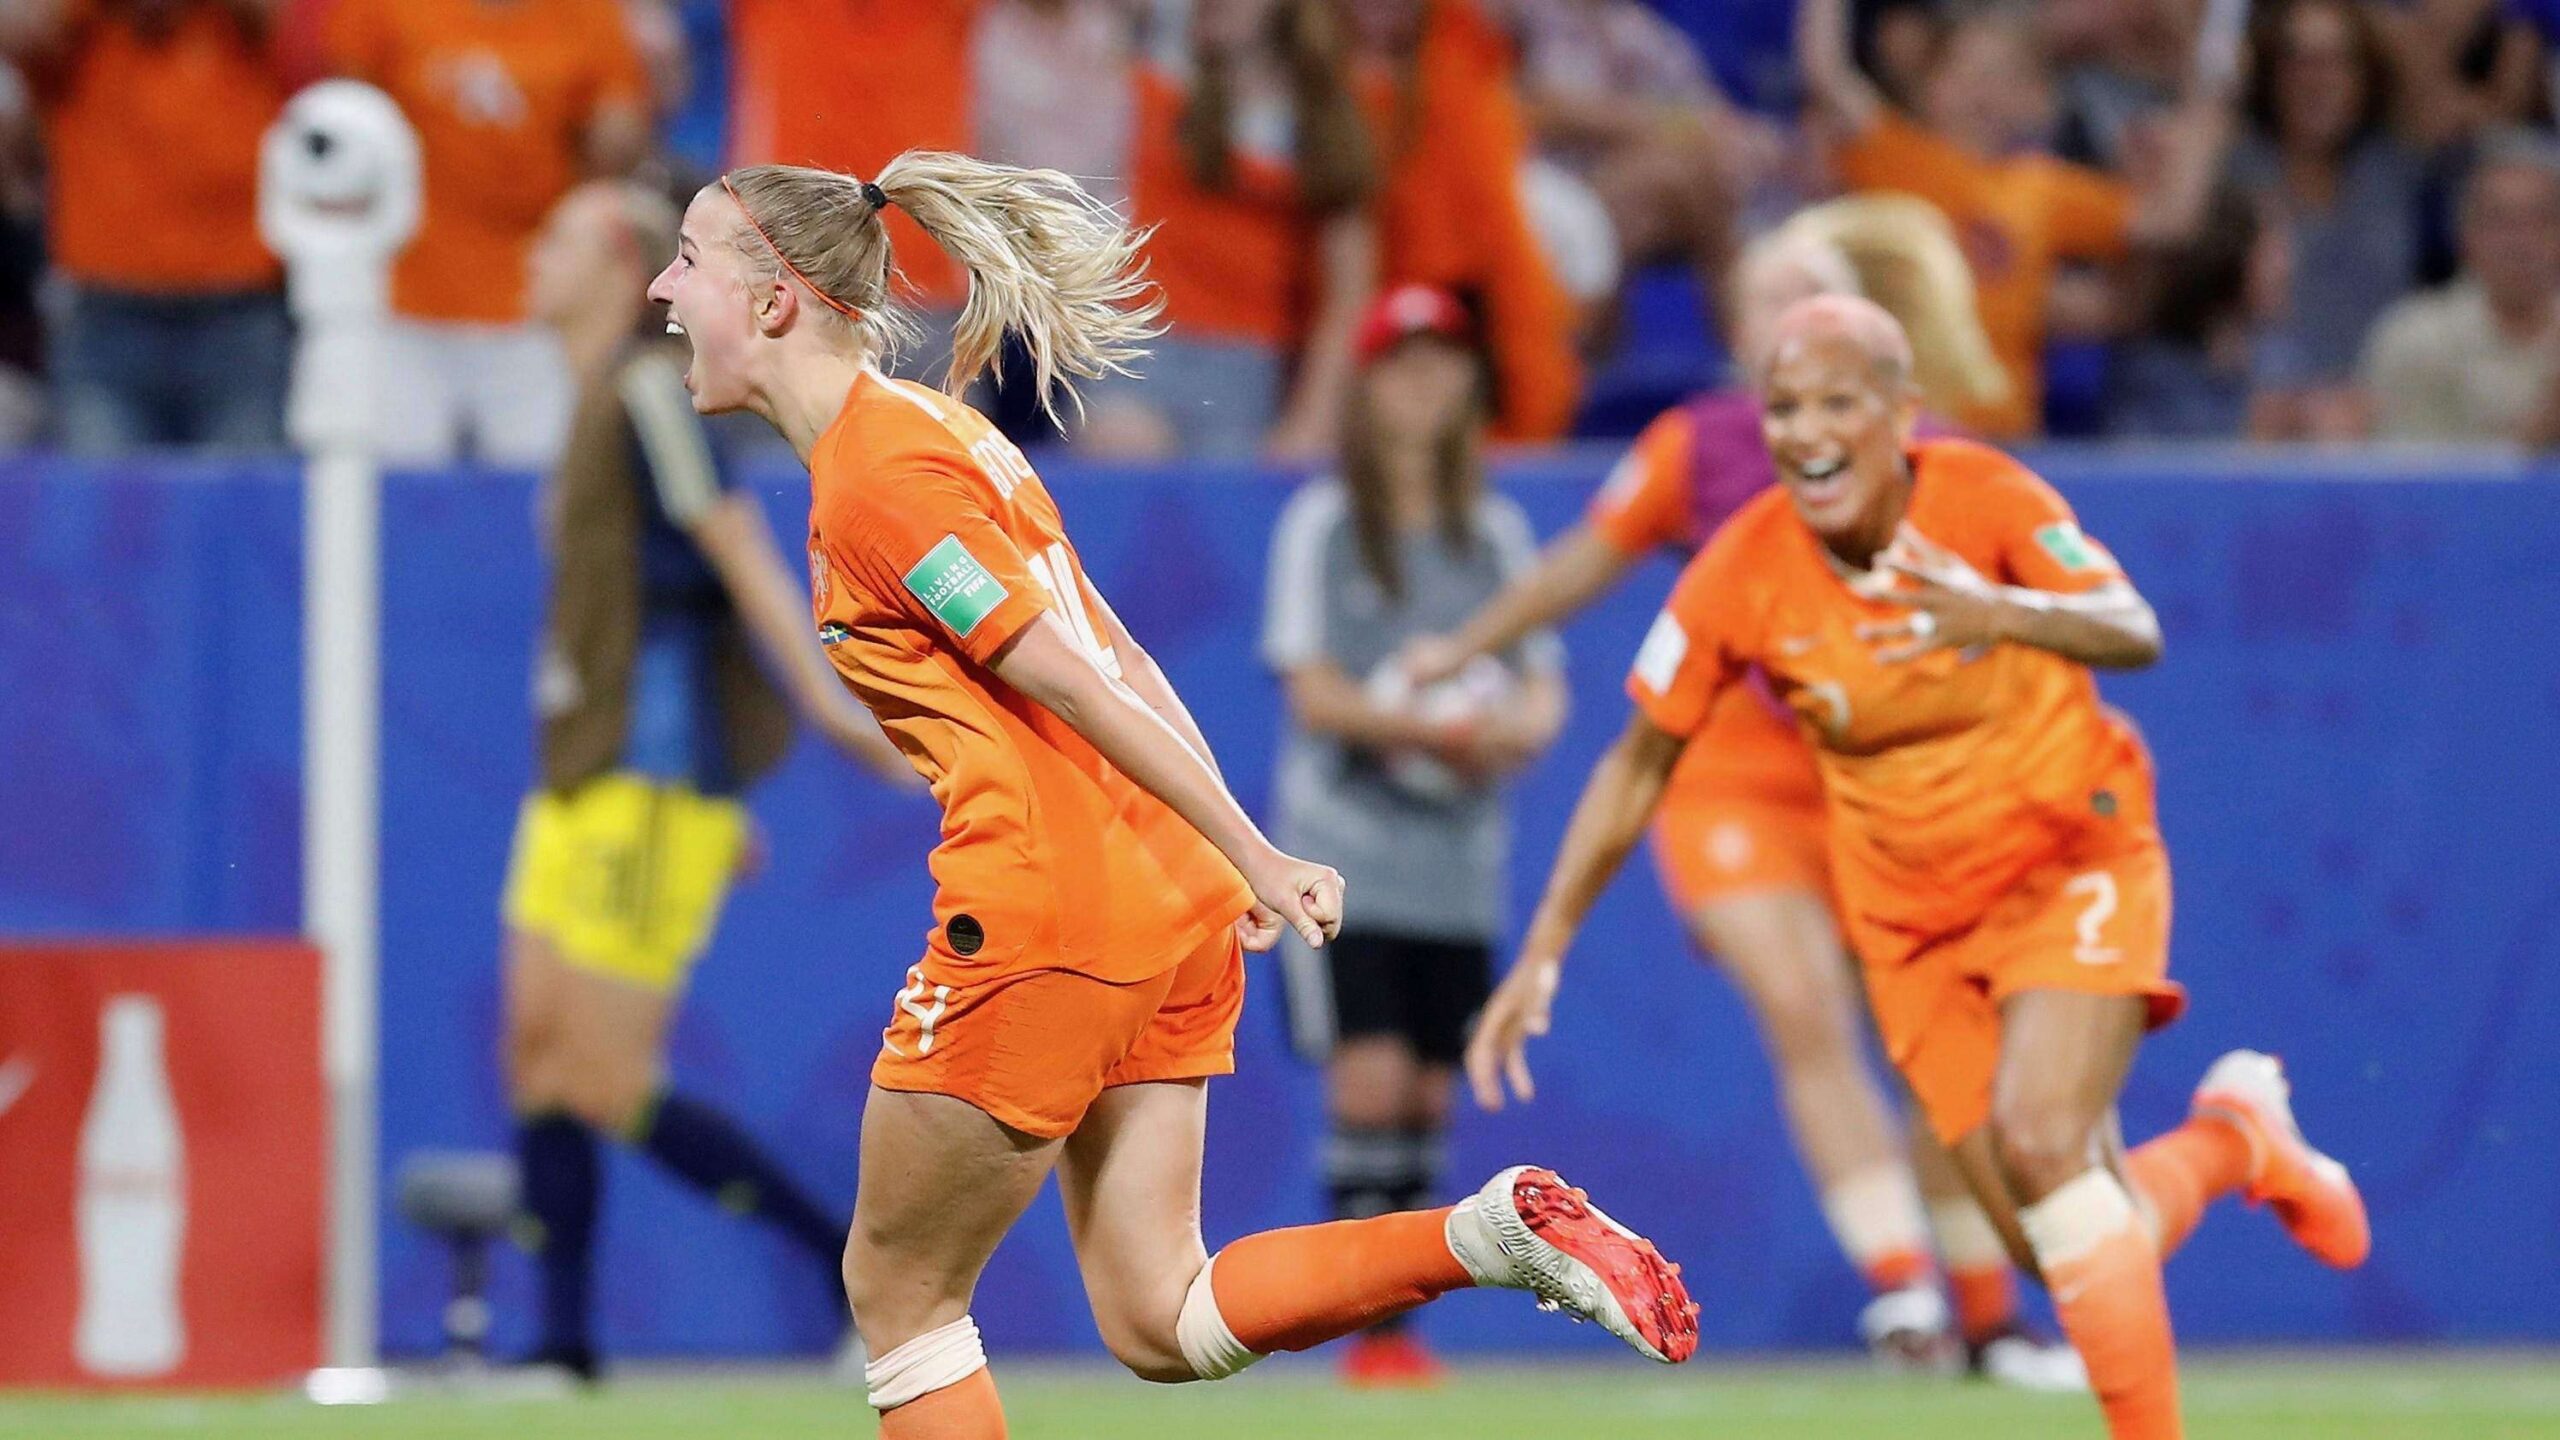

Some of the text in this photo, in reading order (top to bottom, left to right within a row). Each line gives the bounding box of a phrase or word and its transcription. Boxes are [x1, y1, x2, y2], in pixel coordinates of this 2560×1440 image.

[923, 555, 968, 599] LIVING
[929, 563, 975, 605] FOOTBALL
[963, 574, 987, 598] FIFA
[2064, 869, 2119, 945] 7
